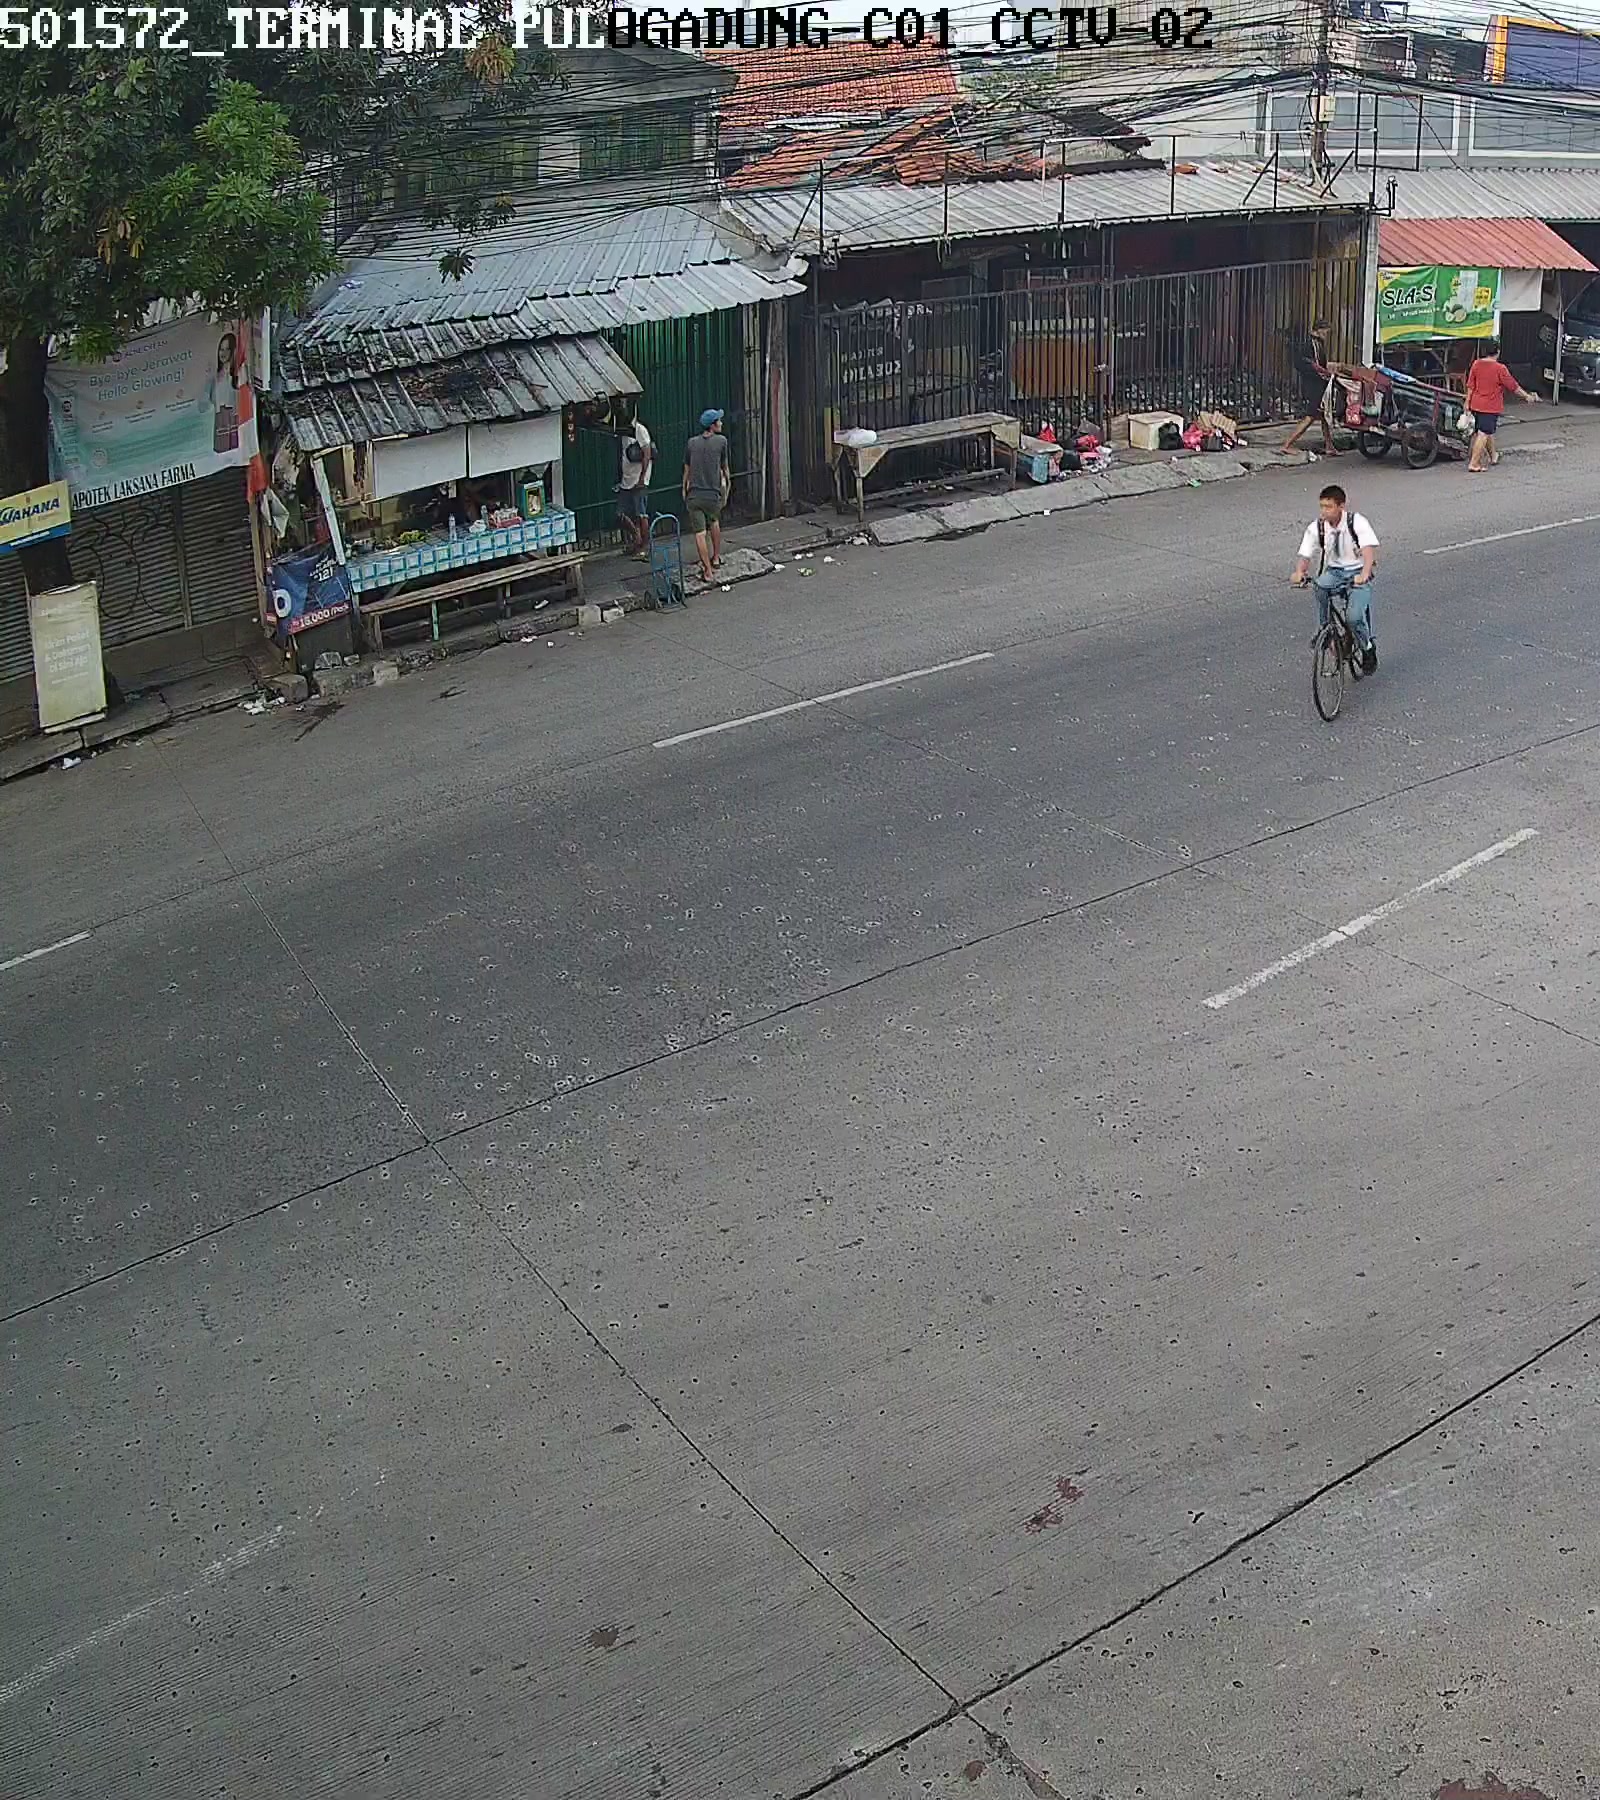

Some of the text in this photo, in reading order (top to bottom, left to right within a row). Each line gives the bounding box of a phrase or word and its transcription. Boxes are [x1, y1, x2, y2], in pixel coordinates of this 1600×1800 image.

[88, 349, 193, 388] Bye-bye Jerawat
[97, 367, 186, 401] Hello Glowing!
[71, 462, 196, 509] APOTEK LAKSANA FARMA
